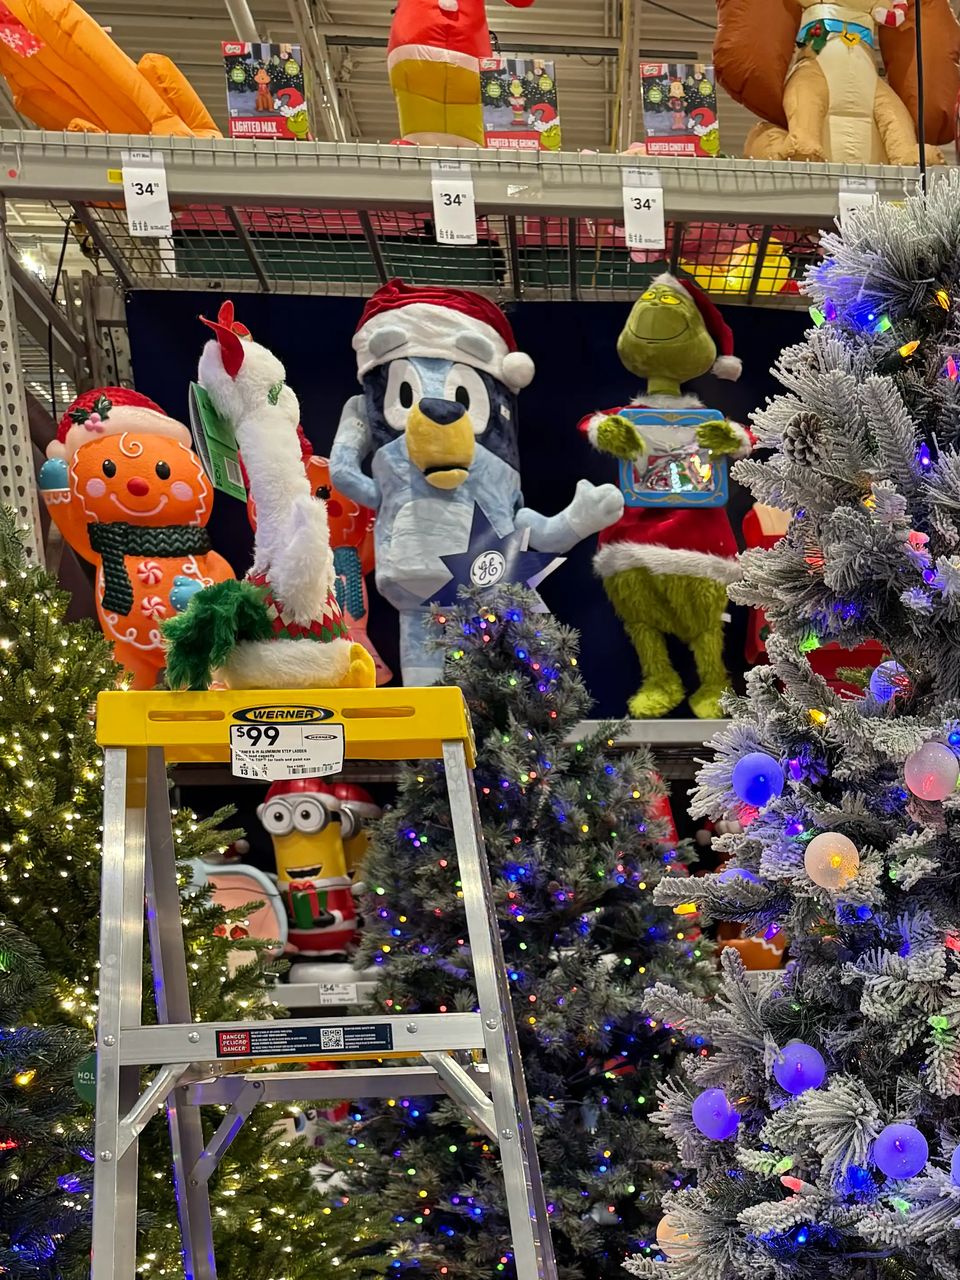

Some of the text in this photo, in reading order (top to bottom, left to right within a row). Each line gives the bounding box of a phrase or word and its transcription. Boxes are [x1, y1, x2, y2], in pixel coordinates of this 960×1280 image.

[231, 120, 278, 133] LIGHTED MAX
[253, 709, 316, 720] WERNER
[236, 726, 281, 747] $99
